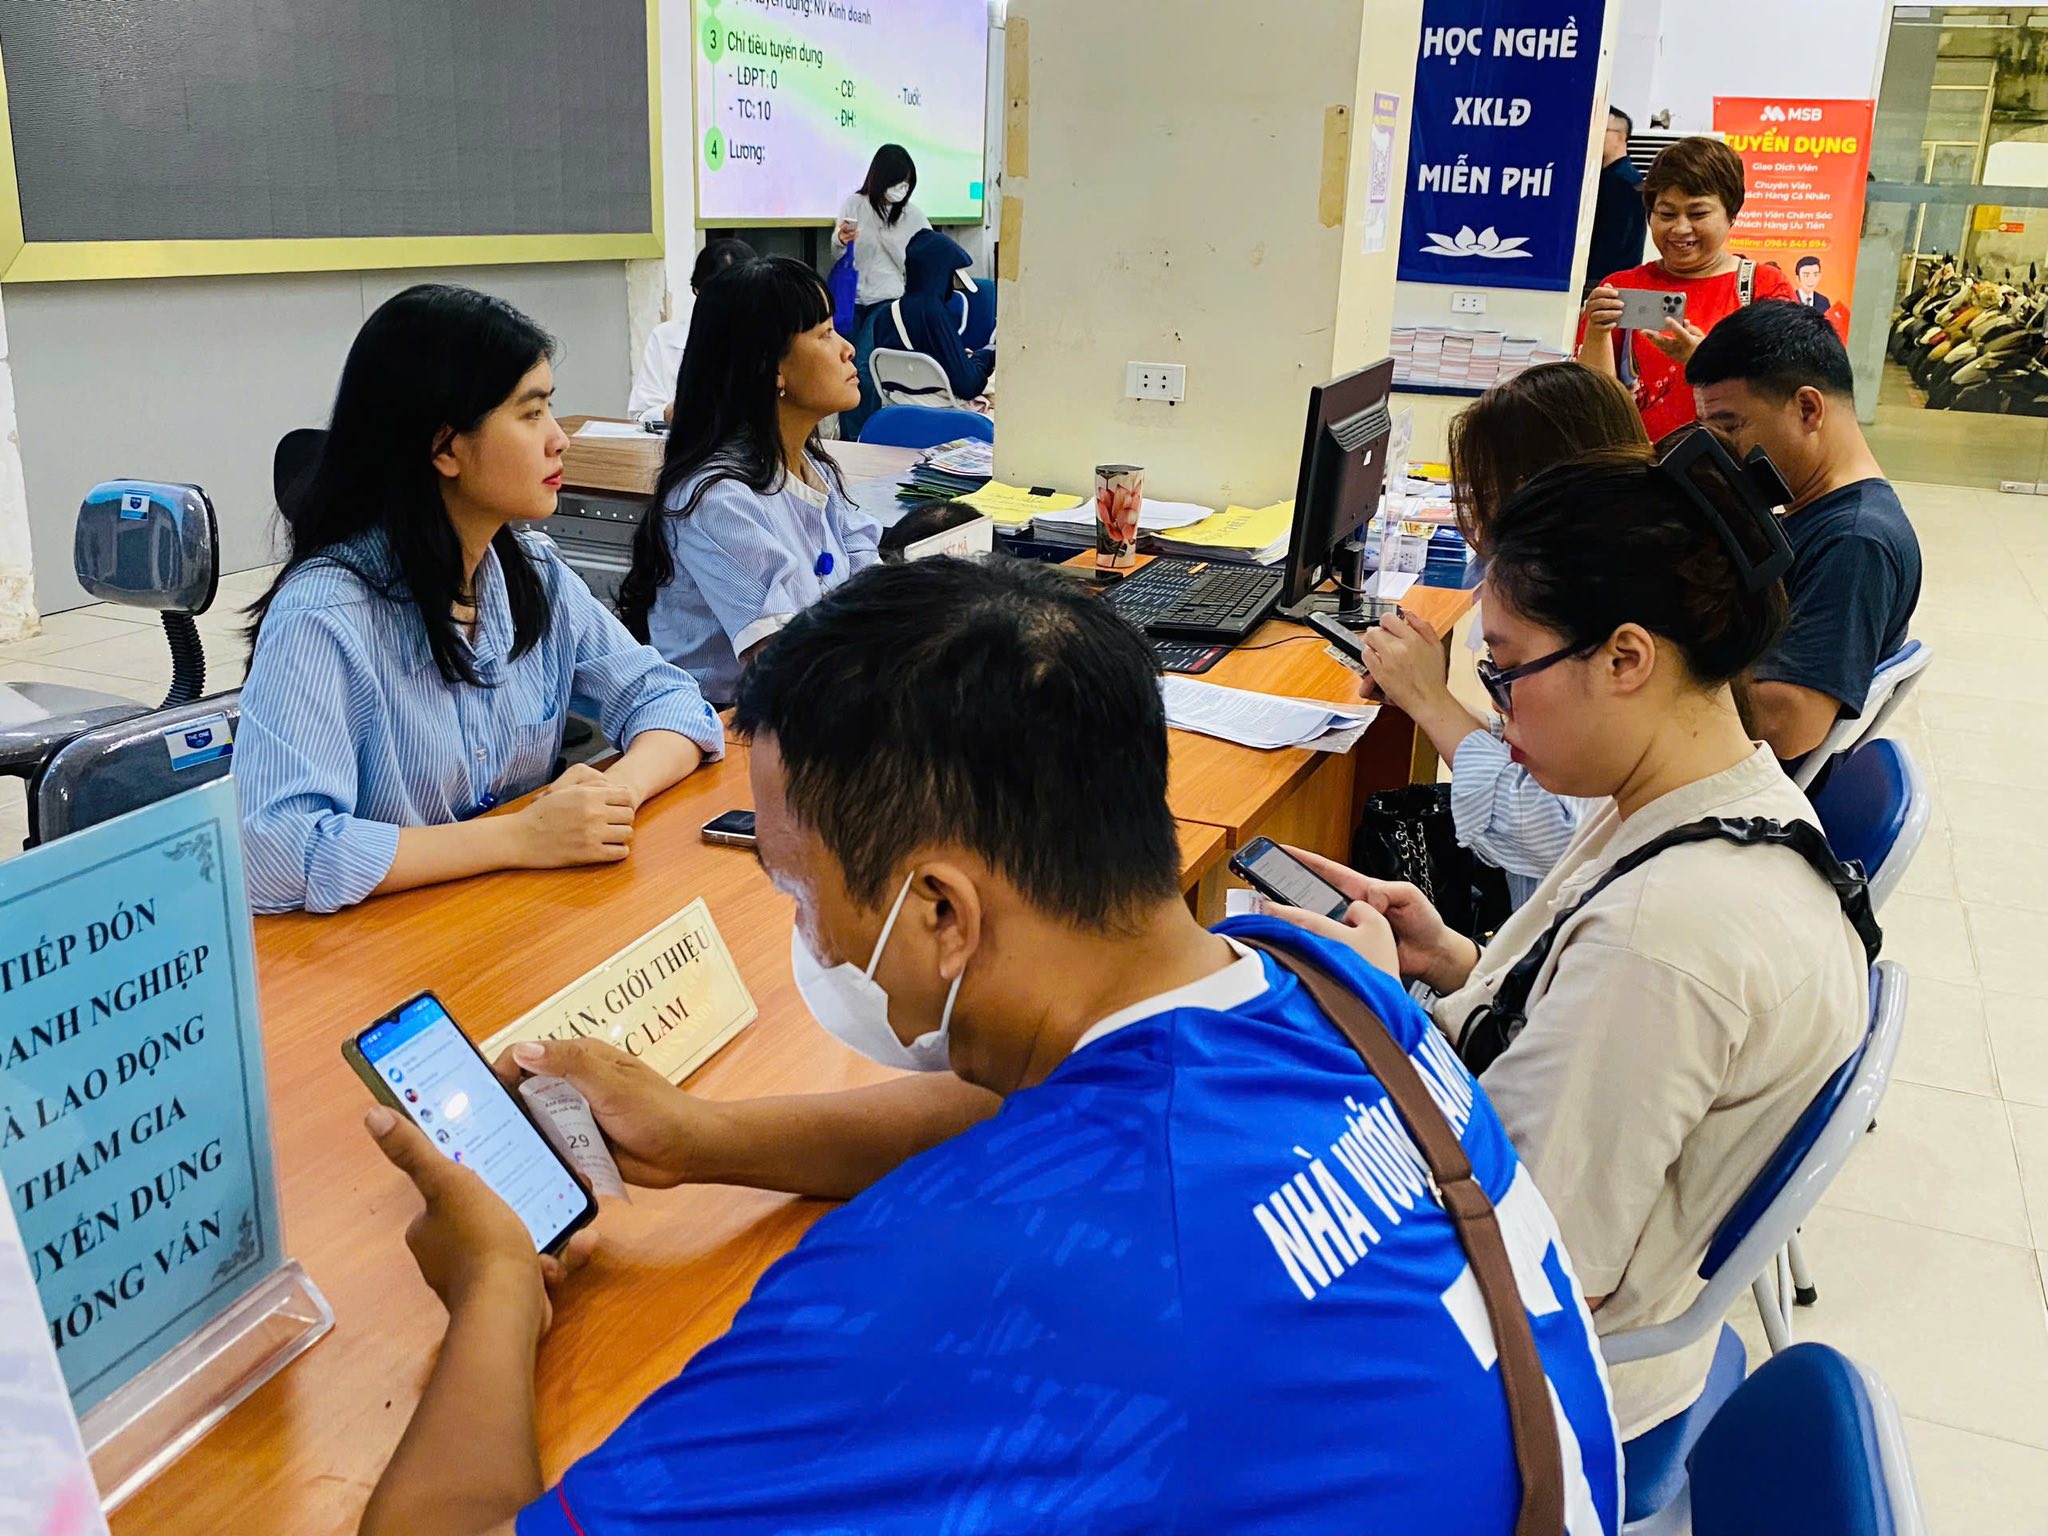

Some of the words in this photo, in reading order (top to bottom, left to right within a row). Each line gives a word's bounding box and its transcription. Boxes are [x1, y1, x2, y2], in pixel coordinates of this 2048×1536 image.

[829, 1, 846, 20] Kinh
[848, 8, 872, 25] doanh
[710, 29, 717, 49] 3
[727, 30, 745, 52] Chỉ
[748, 33, 767, 56] tiêu
[770, 37, 797, 63] tuyển
[800, 42, 823, 68] dụng
[1423, 27, 1483, 65] HỌC
[1493, 16, 1579, 61] NGHỀ
[1452, 97, 1532, 127] XKLĐ
[1788, 107, 1822, 121] MSB
[711, 140, 717, 159] 4
[729, 139, 766, 165] Lương:
[1794, 136, 1857, 158] DỤNG
[1418, 154, 1491, 194] MIỄN
[1501, 162, 1555, 199] PHÍ
[1752, 162, 1773, 171] Giao
[1775, 162, 1796, 172] Dịch
[1797, 163, 1819, 172] Viên
[1755, 181, 1789, 191] Chuyên
[1791, 182, 1812, 190] Viên
[1764, 211, 1785, 219] Viên
[0, 934, 77, 994] TIẾP
[87, 898, 158, 955] ĐÓN
[604, 967, 653, 1014] GIỚI
[650, 926, 711, 980] THIỆU
[0, 1005, 80, 1070] ANH
[89, 944, 210, 1026] NGHIỆP
[642, 996, 690, 1045] LÀM
[35, 1068, 108, 1130] LAO
[116, 1014, 205, 1085] ĐỘNG
[16, 1129, 121, 1213] THAM
[130, 1096, 187, 1145] GIA
[566, 1134, 590, 1149] 29
[129, 1138, 222, 1223] DỤNG
[1253, 1145, 1381, 1300] NHÀ
[154, 1210, 221, 1275] VẤN
